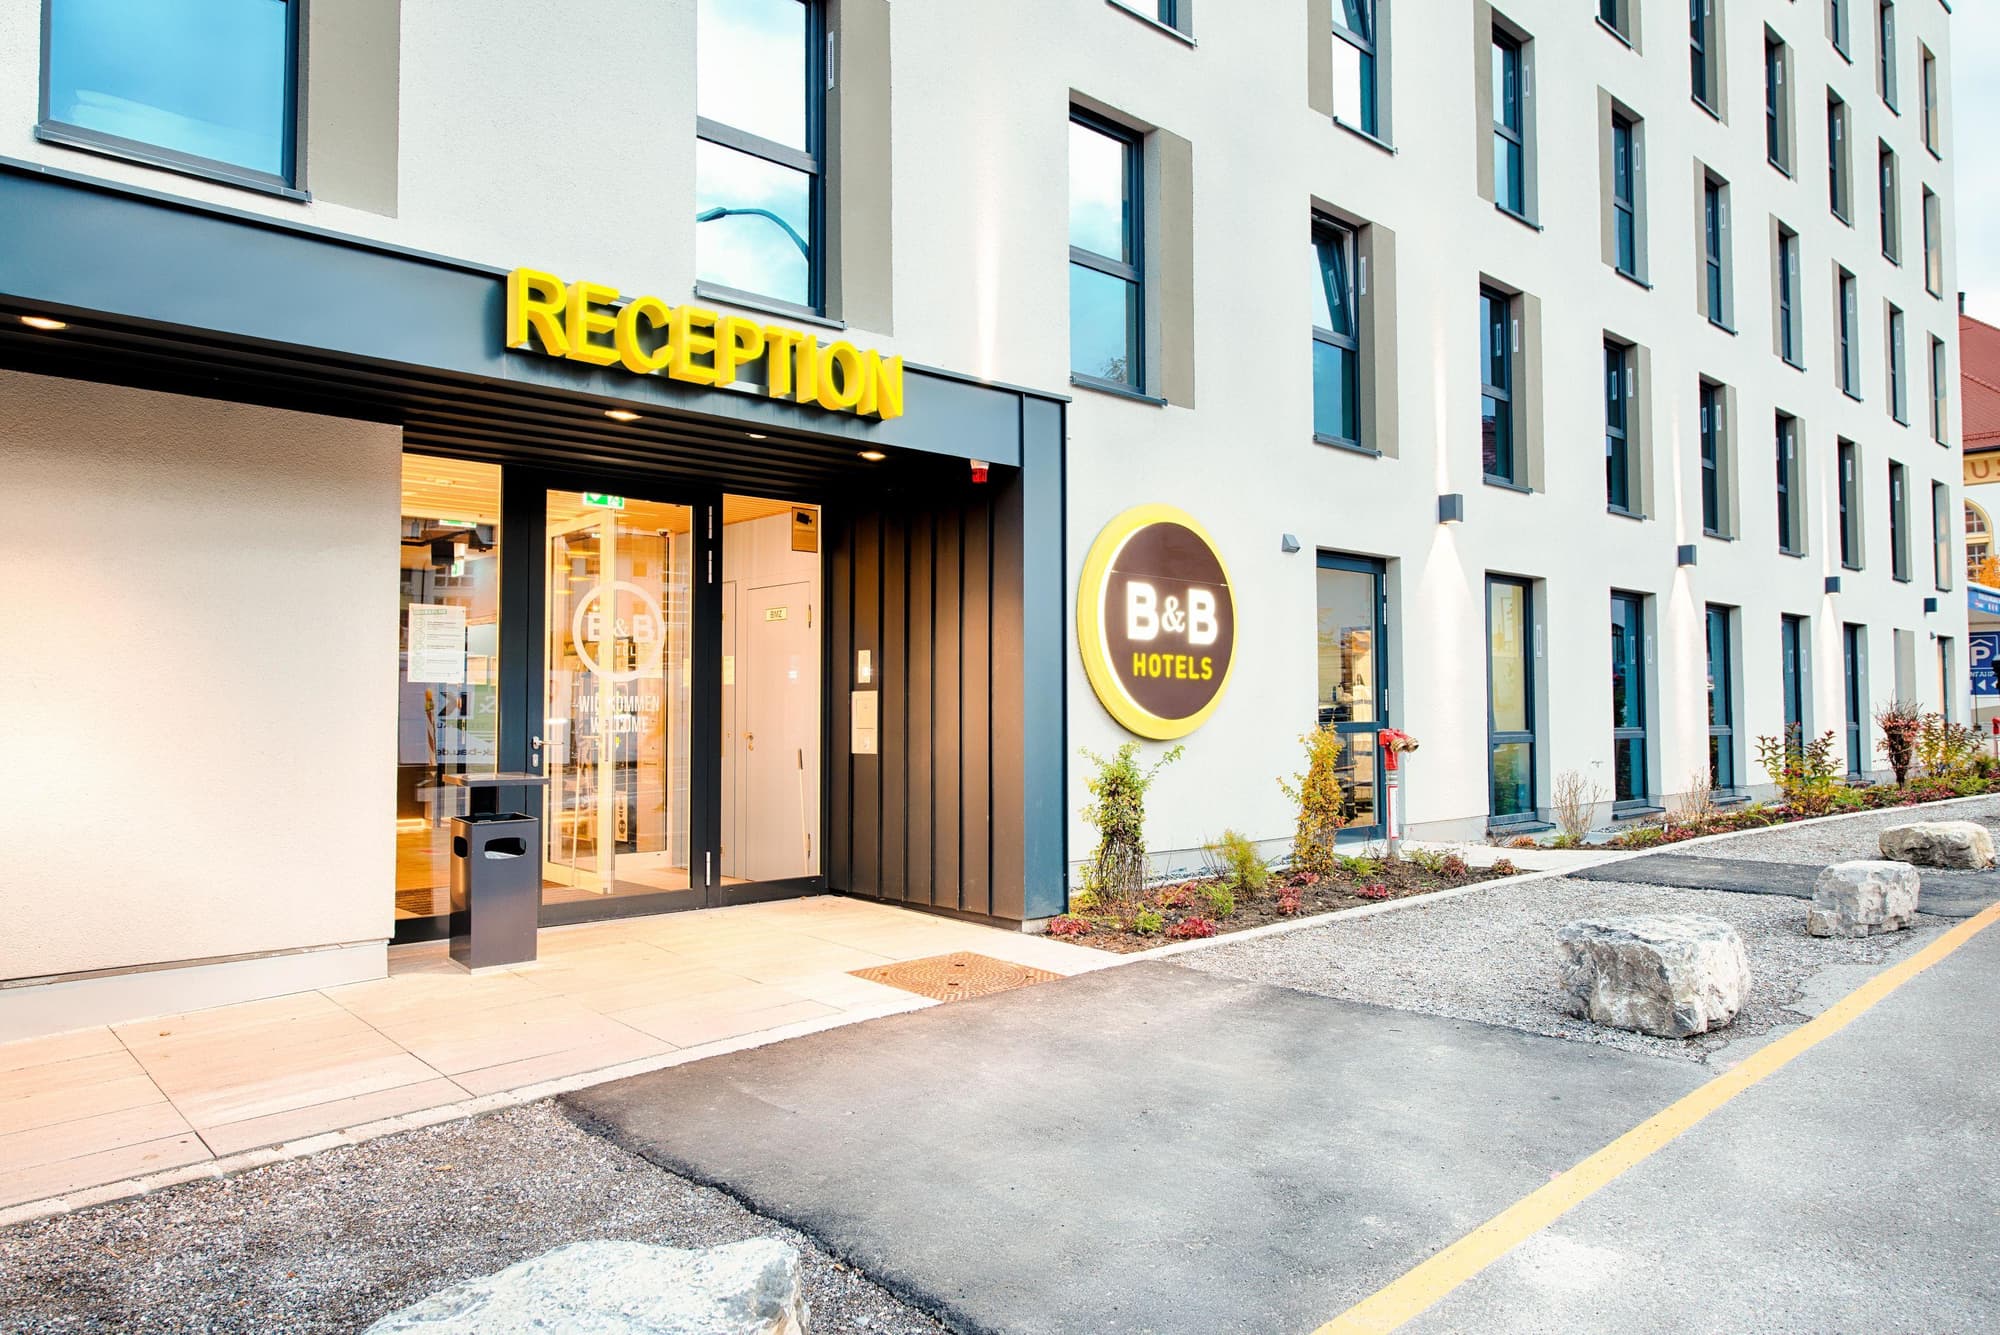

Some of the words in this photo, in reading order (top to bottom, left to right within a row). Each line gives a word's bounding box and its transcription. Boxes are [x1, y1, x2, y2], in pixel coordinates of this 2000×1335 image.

[507, 267, 903, 421] RECEPTION
[769, 609, 783, 619] BMZ
[1127, 581, 1218, 645] B&B
[1133, 652, 1213, 680] HOTELS
[1970, 646, 1990, 667] P
[579, 695, 659, 713] WILKOMMEN
